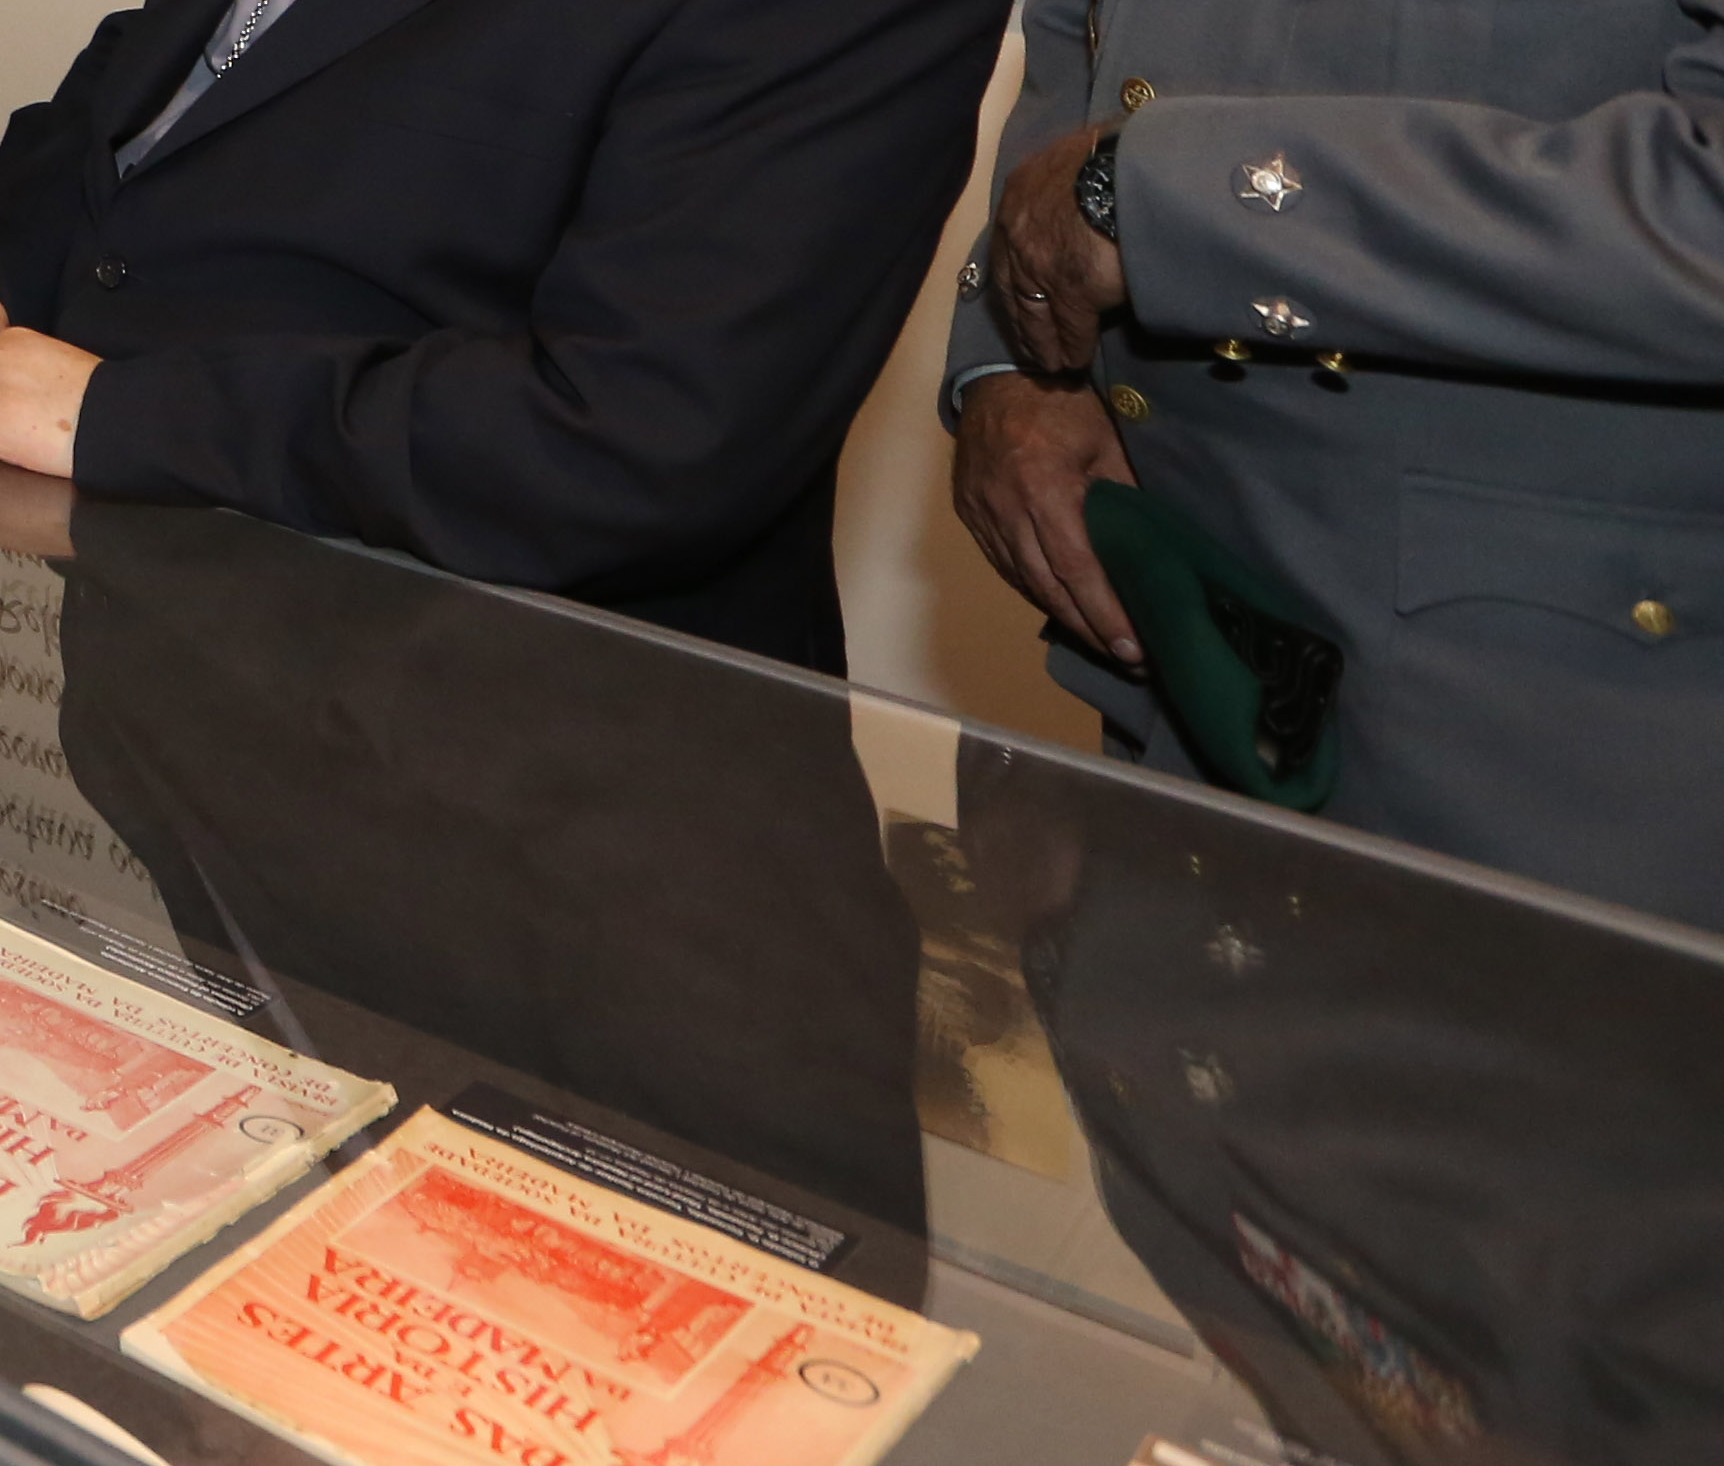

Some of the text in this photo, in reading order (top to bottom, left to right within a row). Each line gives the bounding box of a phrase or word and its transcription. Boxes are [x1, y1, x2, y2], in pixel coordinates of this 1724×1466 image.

[0, 946, 97, 995] MADEIRA
[75, 994, 103, 1009] DA
[112, 996, 143, 1015] DA
[50, 1117, 88, 1142] DA
[325, 1246, 573, 1383] MADEIRA
[238, 1301, 432, 1411] ARTES
[307, 1274, 599, 1433] HISTORIA
